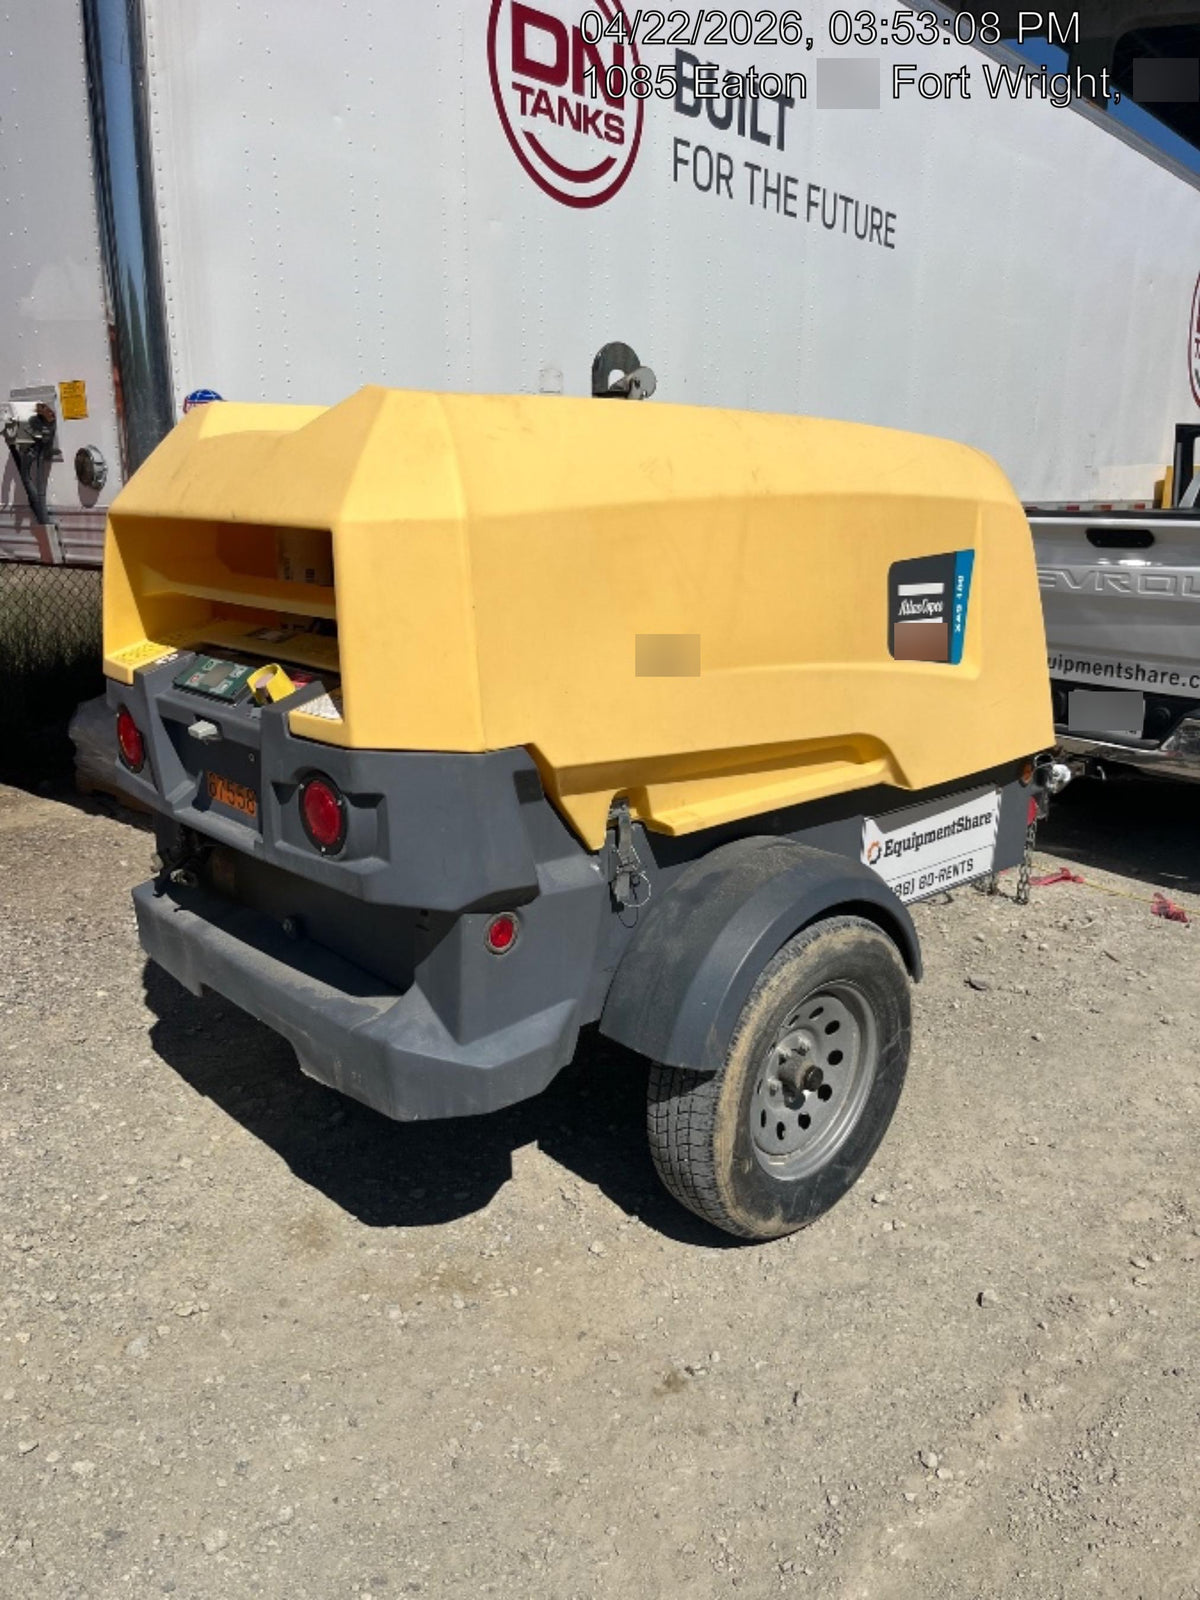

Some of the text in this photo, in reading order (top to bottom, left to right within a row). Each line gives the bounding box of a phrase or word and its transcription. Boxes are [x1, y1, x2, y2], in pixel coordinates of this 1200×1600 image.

[511, 0, 625, 111] DN
[674, 48, 796, 152] BUILT
[511, 81, 625, 146] TANKS
[673, 136, 897, 250] FOR THE FUTURE
[883, 811, 993, 858] EquipmentShare
